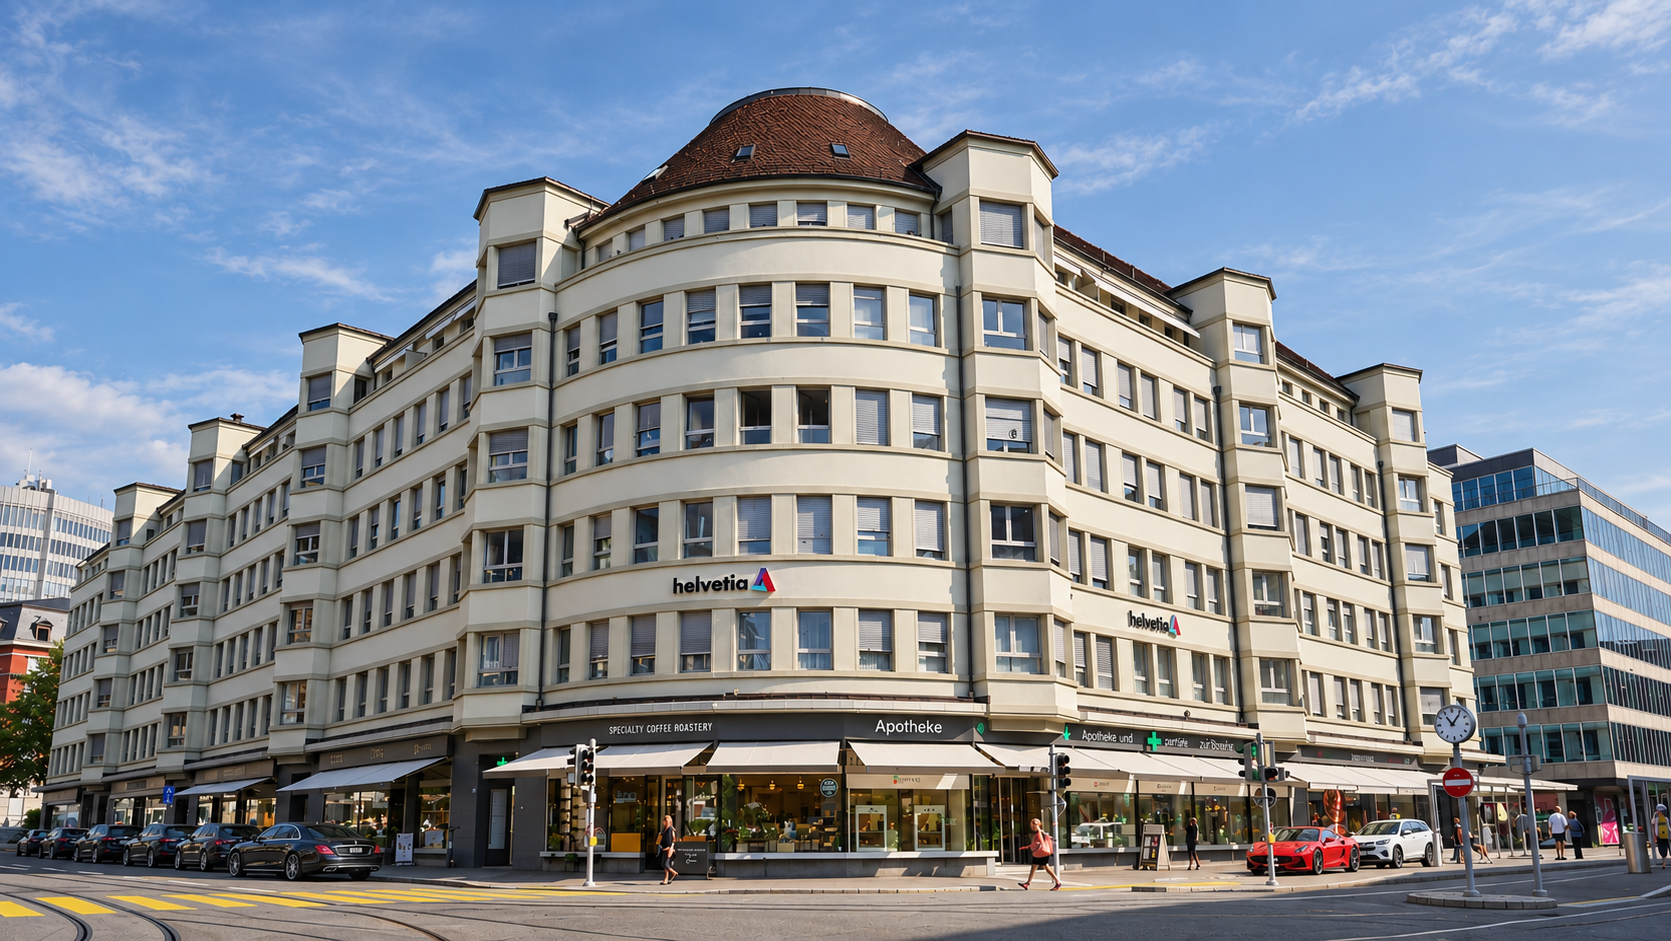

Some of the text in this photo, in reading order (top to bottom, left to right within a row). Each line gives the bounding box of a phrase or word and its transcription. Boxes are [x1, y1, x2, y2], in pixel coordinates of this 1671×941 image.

[673, 574, 748, 594] helvetia
[1128, 610, 1169, 632] helvetia
[609, 722, 713, 735] SPECIALTY COFFEE ROASTERY
[875, 719, 943, 736] Apotheke
[1119, 733, 1134, 743] und
